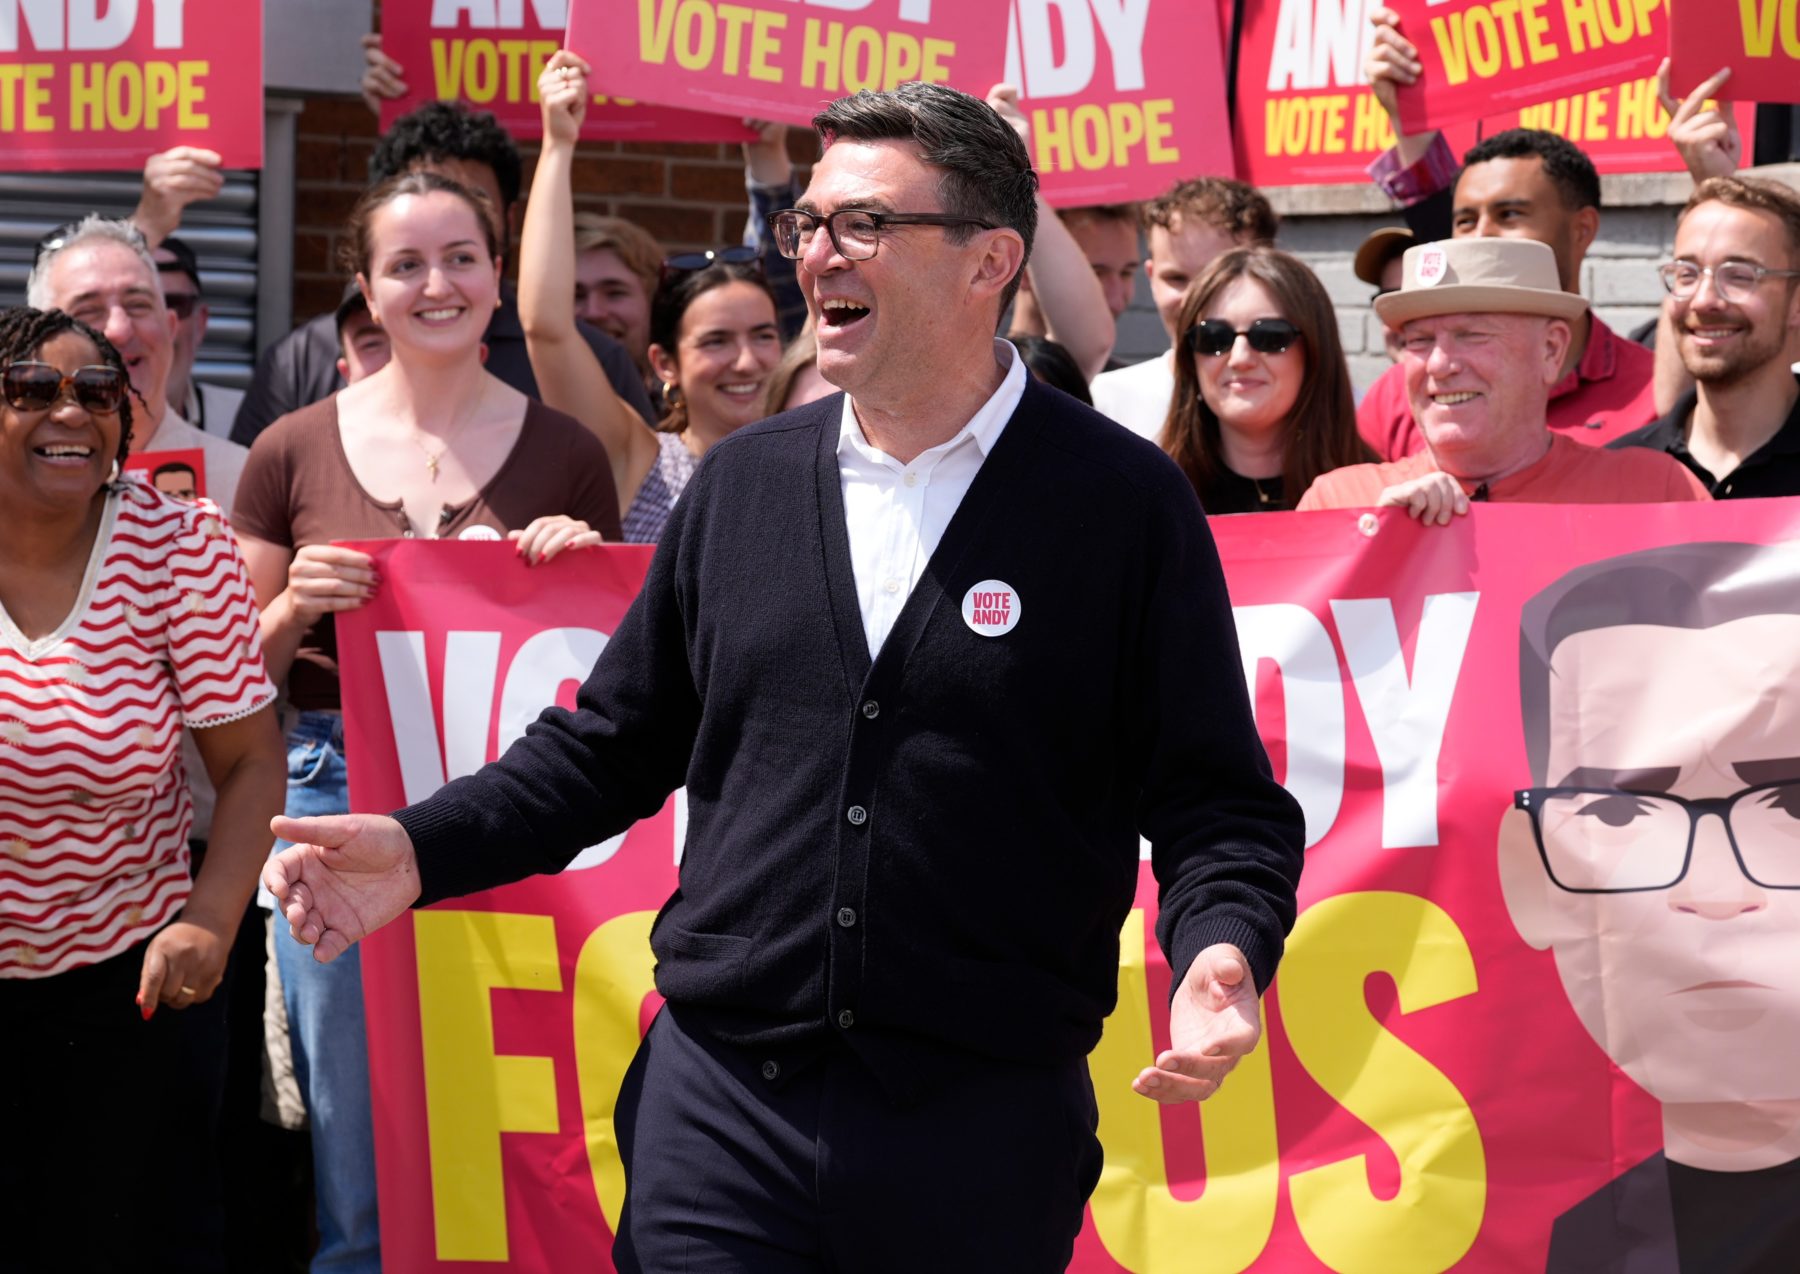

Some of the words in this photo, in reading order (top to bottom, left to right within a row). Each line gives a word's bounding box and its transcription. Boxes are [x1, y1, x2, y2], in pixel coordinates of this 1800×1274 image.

[430, 38, 559, 103] VOTE
[636, 0, 788, 83] VOTE
[799, 18, 956, 95] HOPE
[1001, 0, 1151, 99] DY
[1428, 0, 1559, 85] VOTE
[69, 60, 210, 132] HOPE
[1264, 95, 1349, 156] VOTE
[1031, 98, 1181, 174] HOPE
[972, 591, 1011, 610] VOTE
[972, 609, 1010, 626] ANDY
[1139, 591, 1481, 860] DY
[1086, 890, 1487, 1274] US
